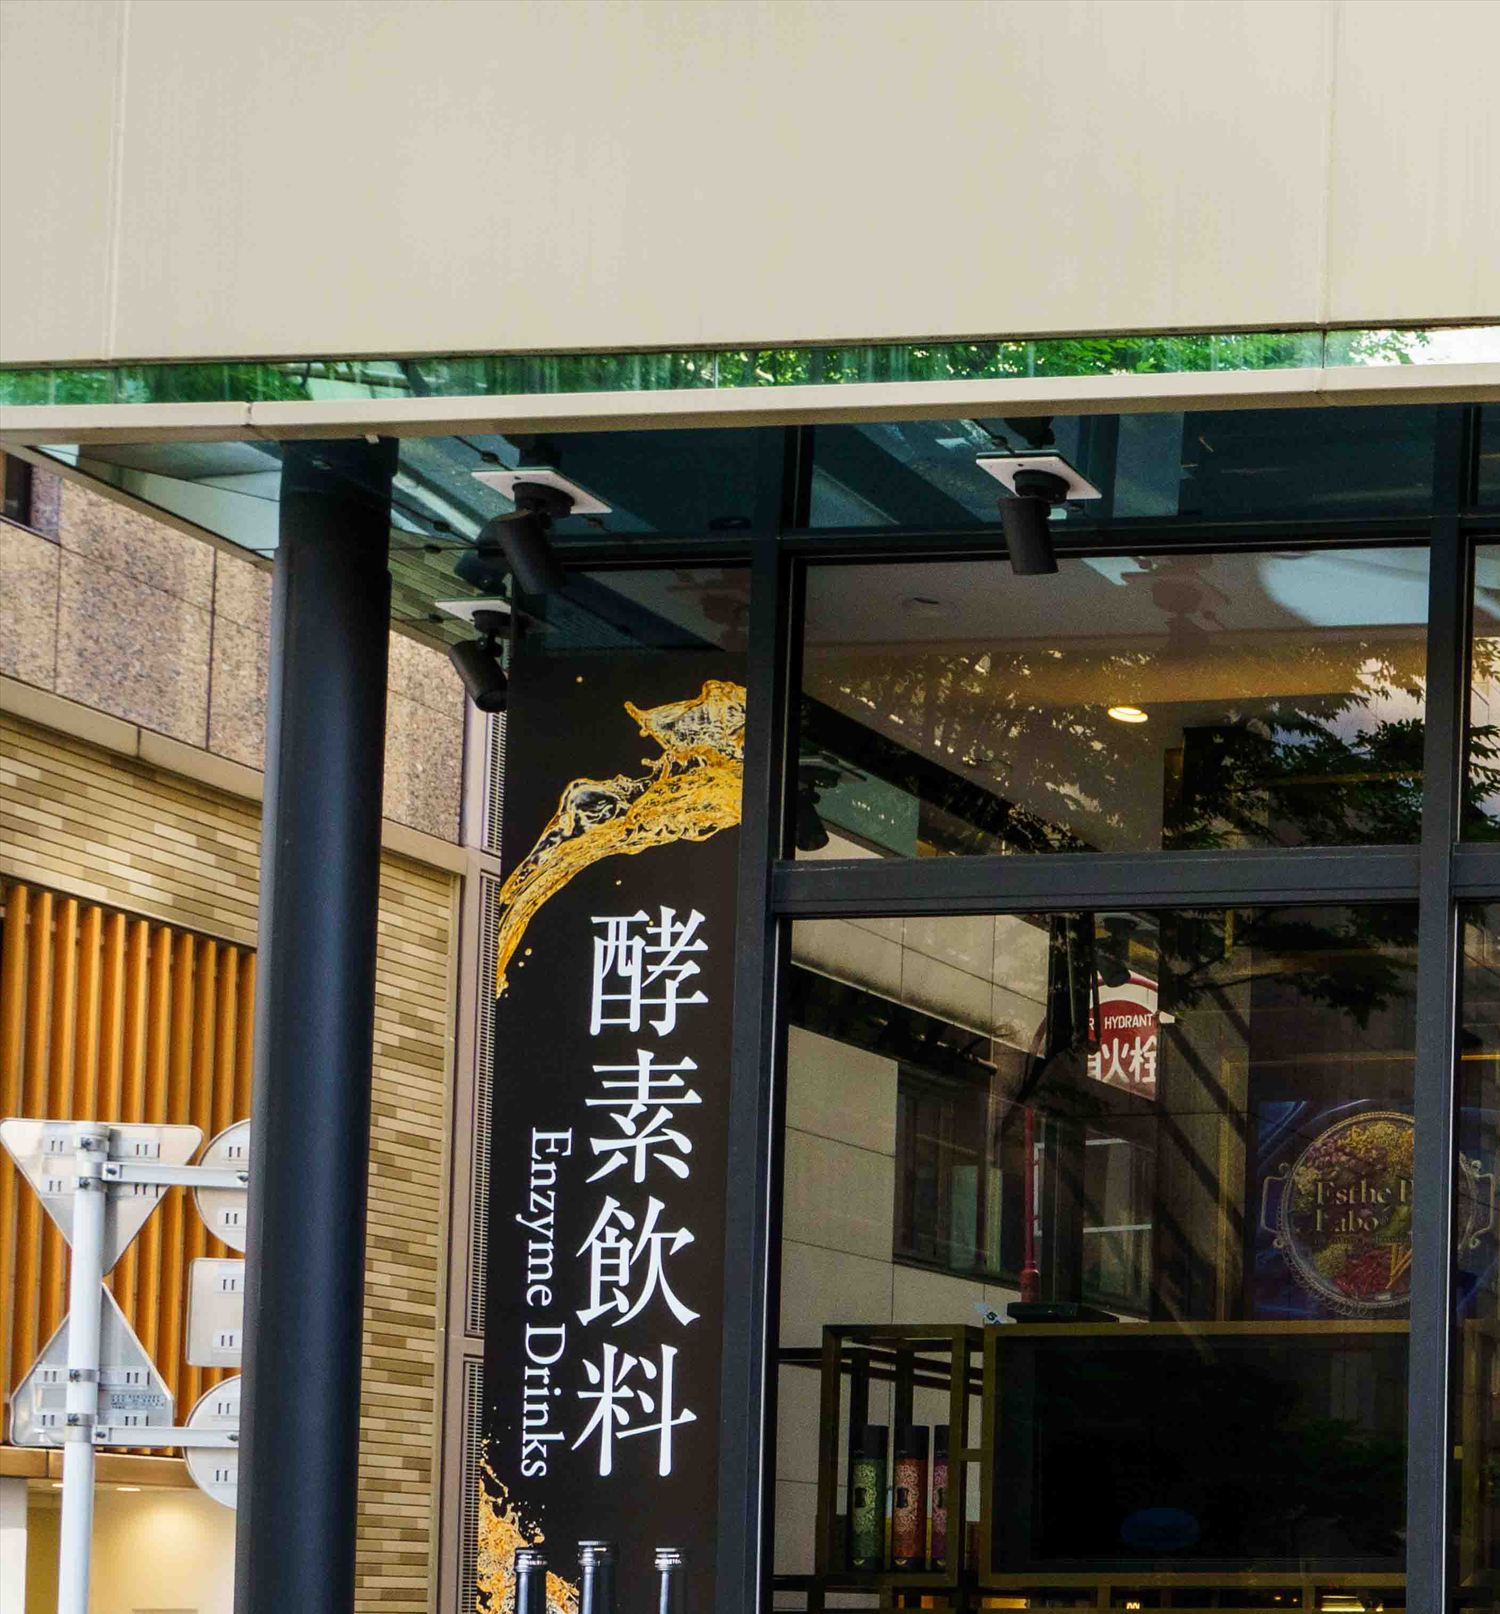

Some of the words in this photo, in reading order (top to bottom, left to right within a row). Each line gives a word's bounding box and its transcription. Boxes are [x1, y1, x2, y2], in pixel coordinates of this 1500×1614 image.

[1104, 1013, 1154, 1029] HYDRANT
[514, 1127, 573, 1307] Enzyme
[571, 906, 709, 1478] 酵素飲料
[520, 1323, 567, 1478] Drinks
